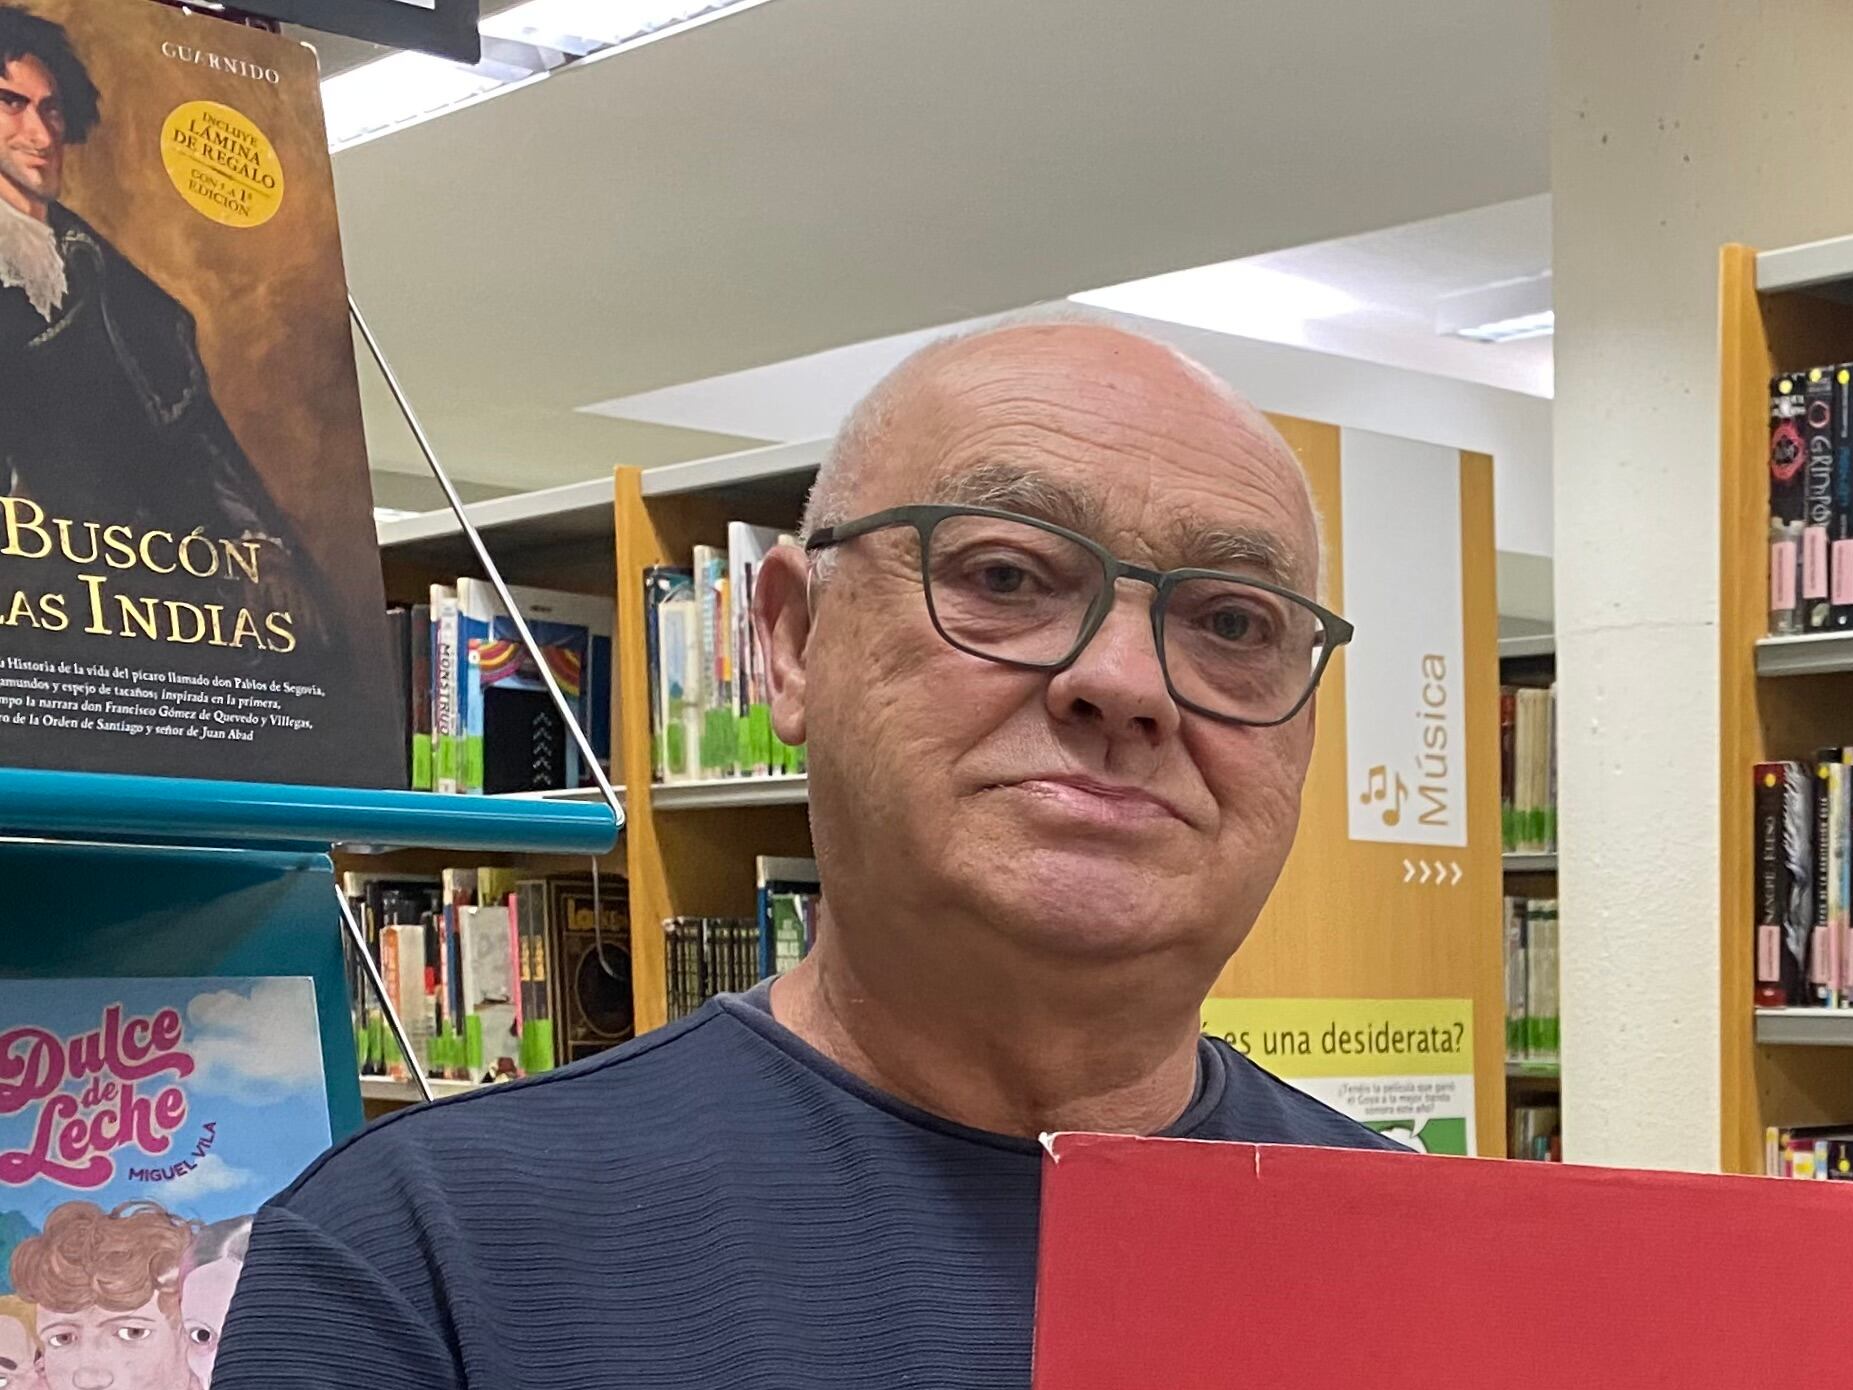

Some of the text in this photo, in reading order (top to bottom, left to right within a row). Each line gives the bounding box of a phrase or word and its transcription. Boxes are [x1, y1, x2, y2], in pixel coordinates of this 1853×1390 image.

[189, 119, 260, 166] LÁMINA
[203, 112, 259, 145] INCLUYE
[173, 129, 276, 190] DE REGALO
[1808, 434, 1832, 530] GRIMPO
[1, 495, 261, 584] BUSCÓN
[77, 574, 297, 653] INDIAS
[8, 656, 55, 673] Historia
[58, 662, 71, 674] de
[74, 663, 84, 676] la
[87, 664, 109, 677] vida
[112, 666, 128, 680] del
[168, 670, 210, 687] llamado
[212, 676, 232, 688] don
[234, 677, 267, 692] Pablos
[269, 680, 282, 693] de
[62, 682, 97, 698] espejo
[99, 685, 111, 696] de
[211, 695, 224, 705] en
[226, 693, 236, 706] la
[12, 713, 26, 725] de
[29, 713, 39, 726] la
[42, 714, 78, 729] Orden
[80, 717, 94, 730] de
[96, 718, 143, 736] Santiago
[186, 725, 199, 738] de
[199, 726, 226, 741] Juan
[228, 728, 254, 742] Abad
[25, 695, 36, 708] la
[81, 699, 102, 712] don
[105, 701, 156, 717] Francisco
[158, 705, 196, 720] Gómez
[199, 708, 212, 721] de
[214, 709, 258, 726] Quevedo
[1415, 653, 1450, 827] Música
[0, 1004, 195, 1113] Dulce
[1263, 1031, 1312, 1055] una
[1322, 1021, 1465, 1056] desiderata?
[83, 1076, 118, 1110] de
[0, 1080, 189, 1190] Leche
[128, 1119, 219, 1184] MIGUEL VILA
